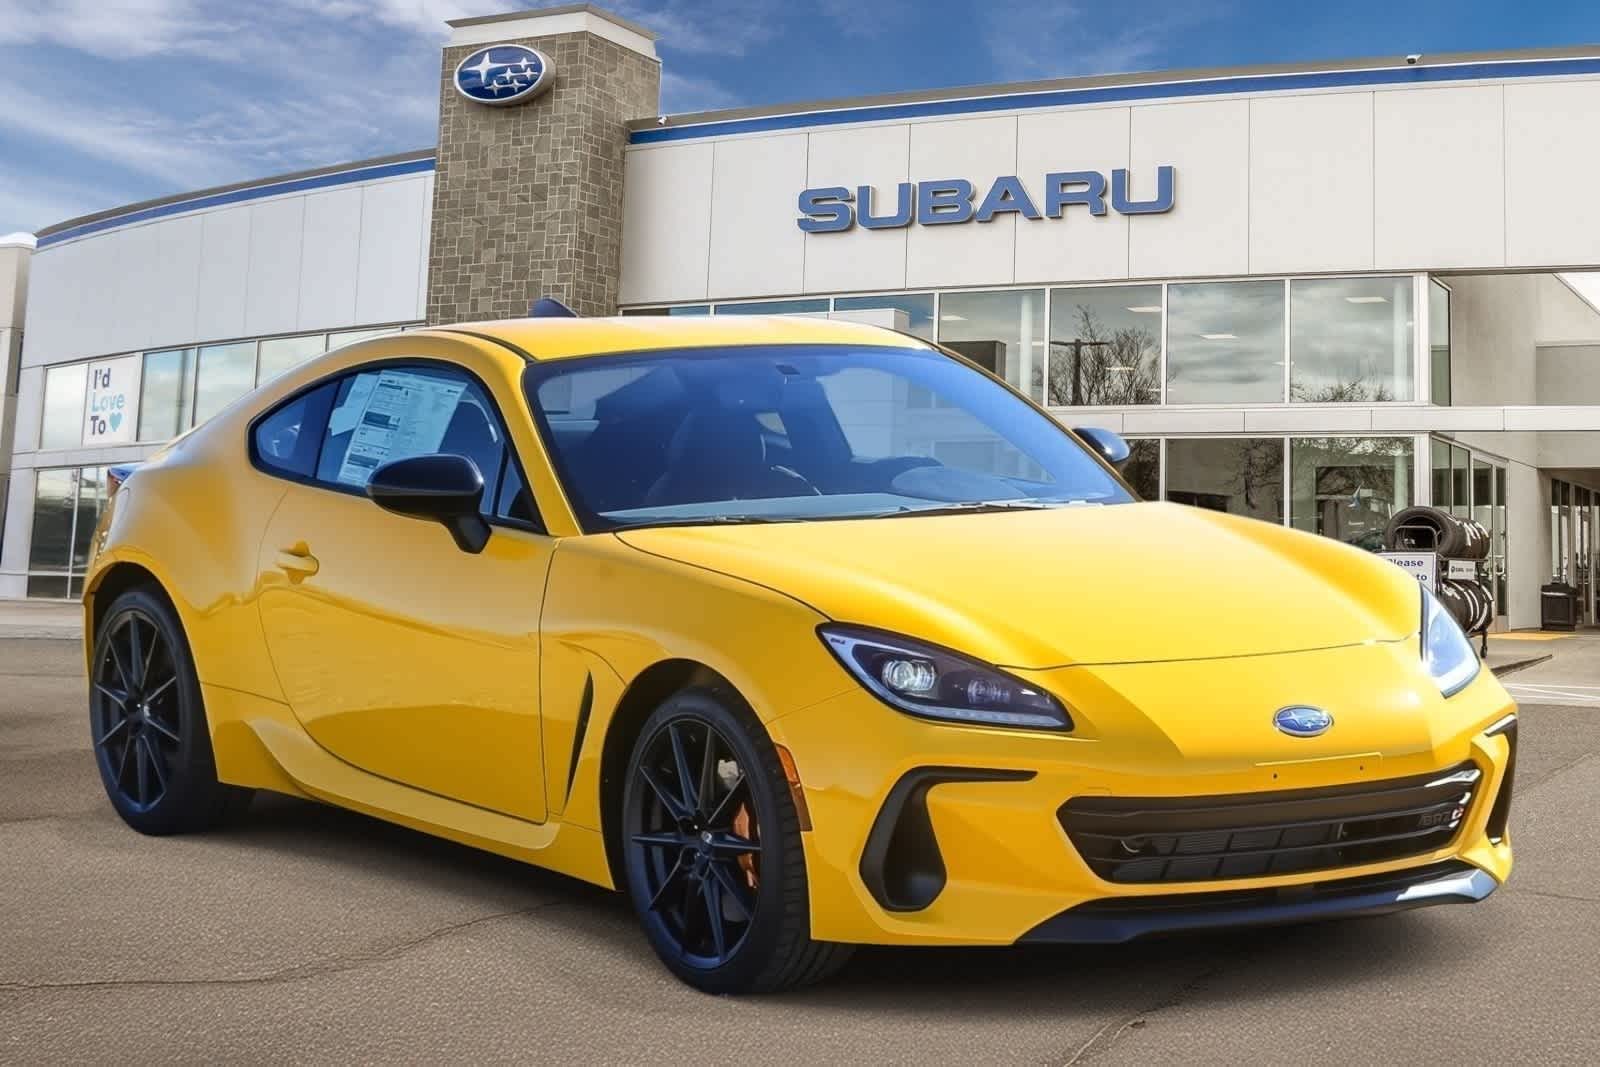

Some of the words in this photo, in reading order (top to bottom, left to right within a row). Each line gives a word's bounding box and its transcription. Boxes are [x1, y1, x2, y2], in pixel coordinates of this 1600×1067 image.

[797, 165, 1175, 233] SUBARU
[93, 367, 111, 390] I'd
[91, 391, 125, 412] Love
[90, 415, 107, 436] To
